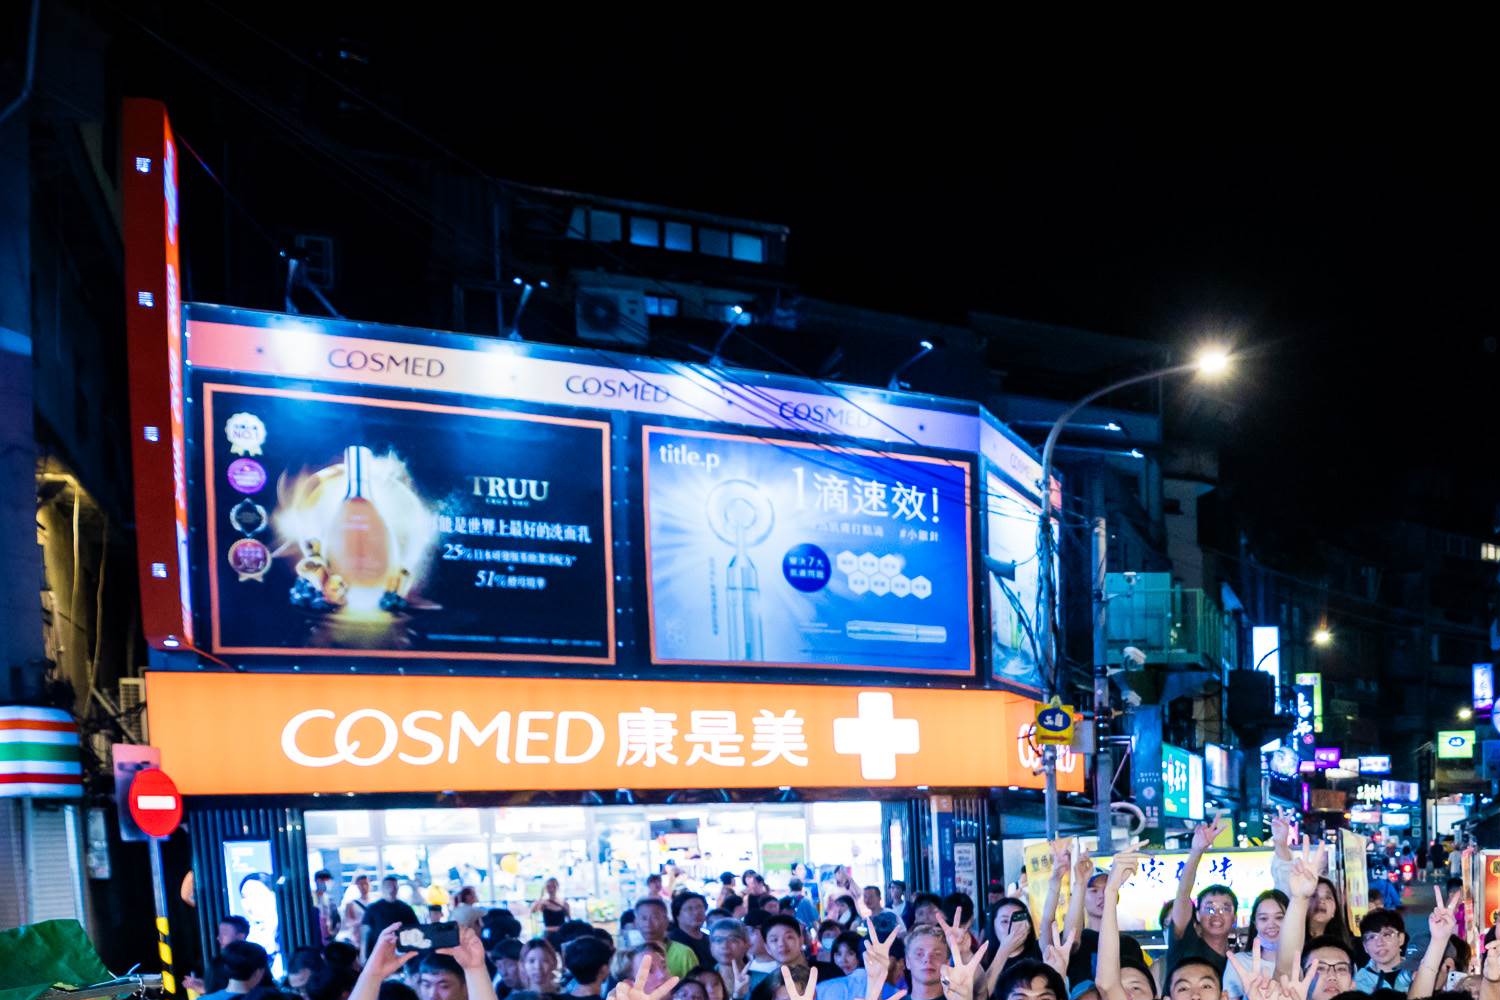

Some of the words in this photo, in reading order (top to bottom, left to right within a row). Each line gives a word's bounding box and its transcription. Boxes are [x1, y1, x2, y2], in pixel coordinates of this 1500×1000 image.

[327, 348, 446, 379] COSMED
[565, 375, 671, 404] COSMED
[778, 402, 872, 428] COSMED
[659, 444, 721, 472] title.p
[468, 475, 550, 501] TRUU
[792, 466, 940, 524] 1滴速效!
[280, 708, 606, 768] COSMED
[616, 707, 810, 769] 康是美
